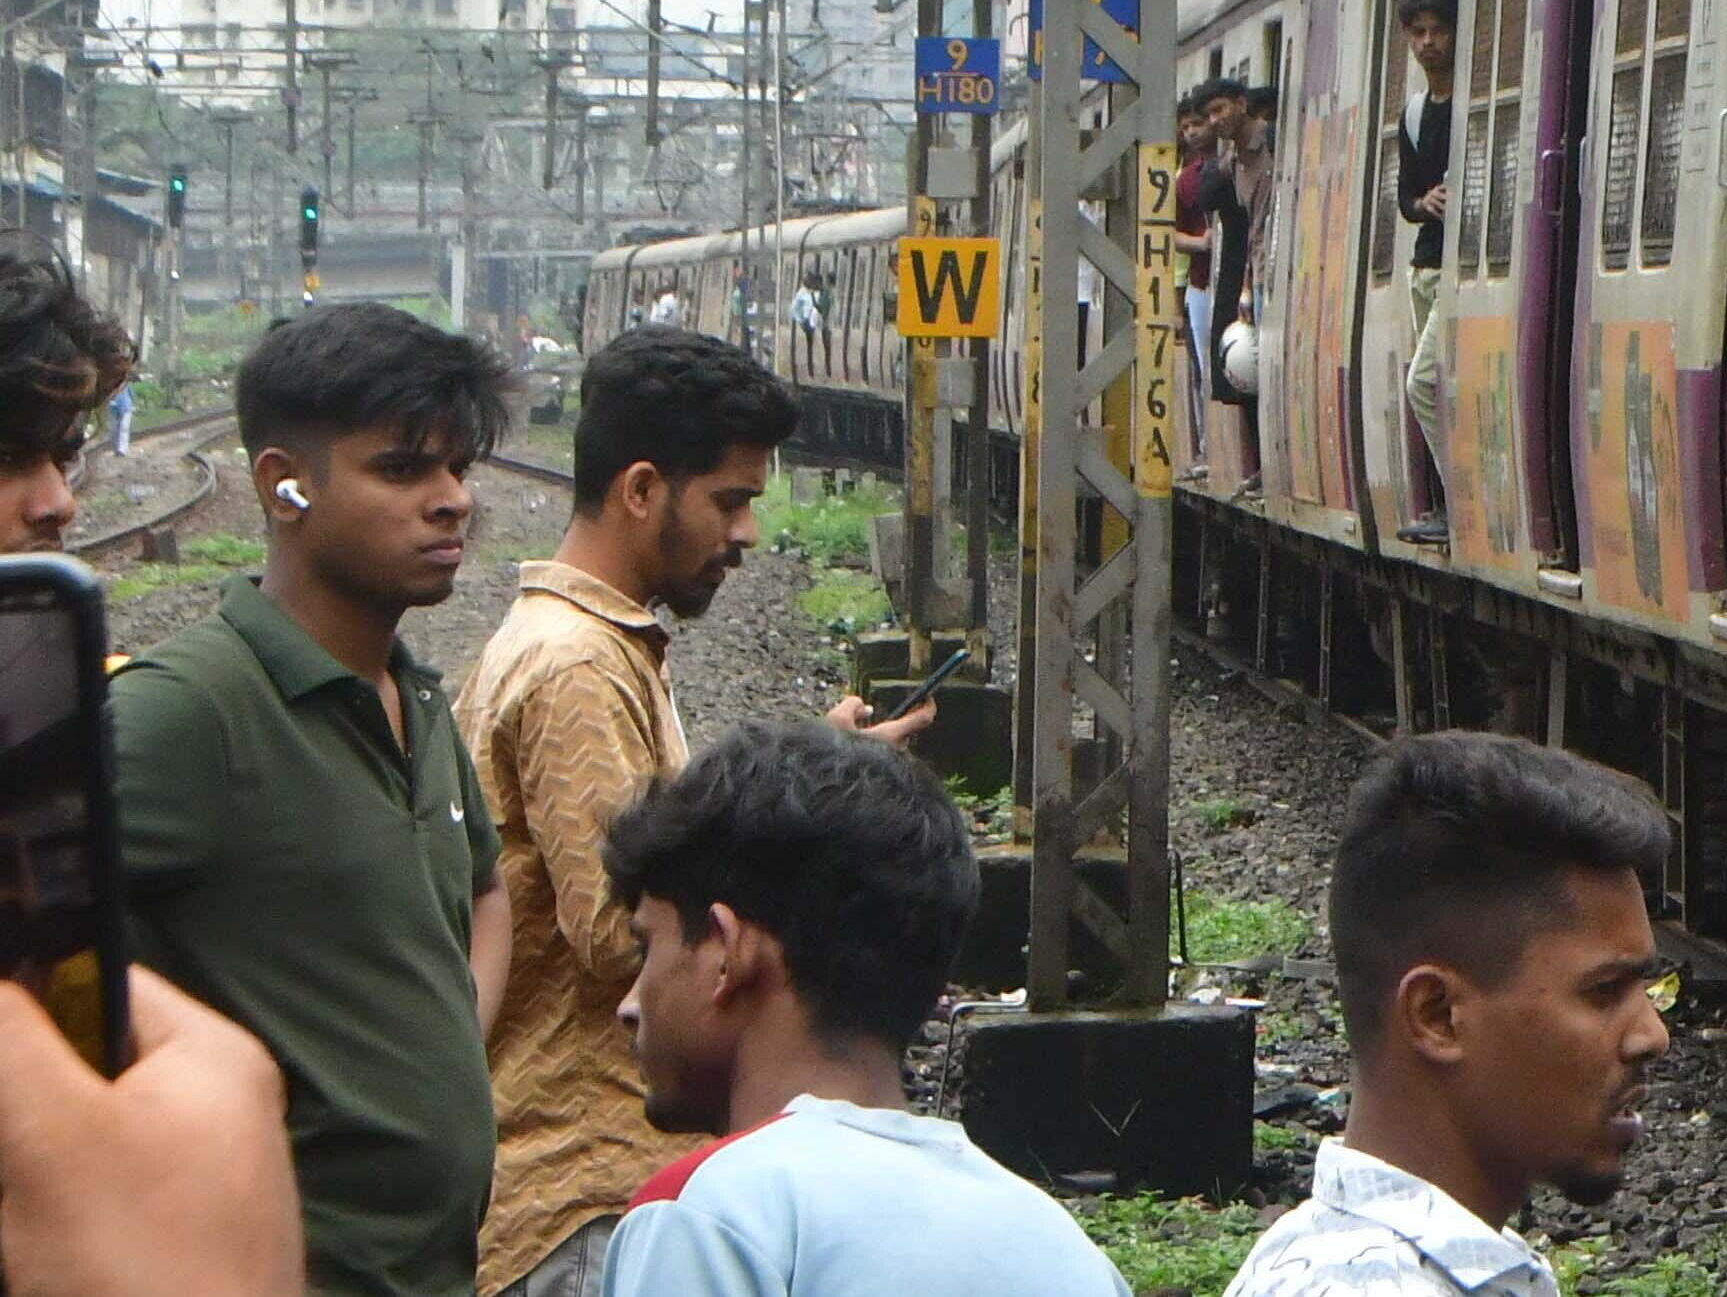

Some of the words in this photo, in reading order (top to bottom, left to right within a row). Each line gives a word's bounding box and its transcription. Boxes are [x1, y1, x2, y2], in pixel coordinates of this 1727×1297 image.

[947, 40, 969, 70] 9
[918, 76, 994, 104] H180
[1147, 167, 1170, 215] 9
[910, 249, 989, 325] W
